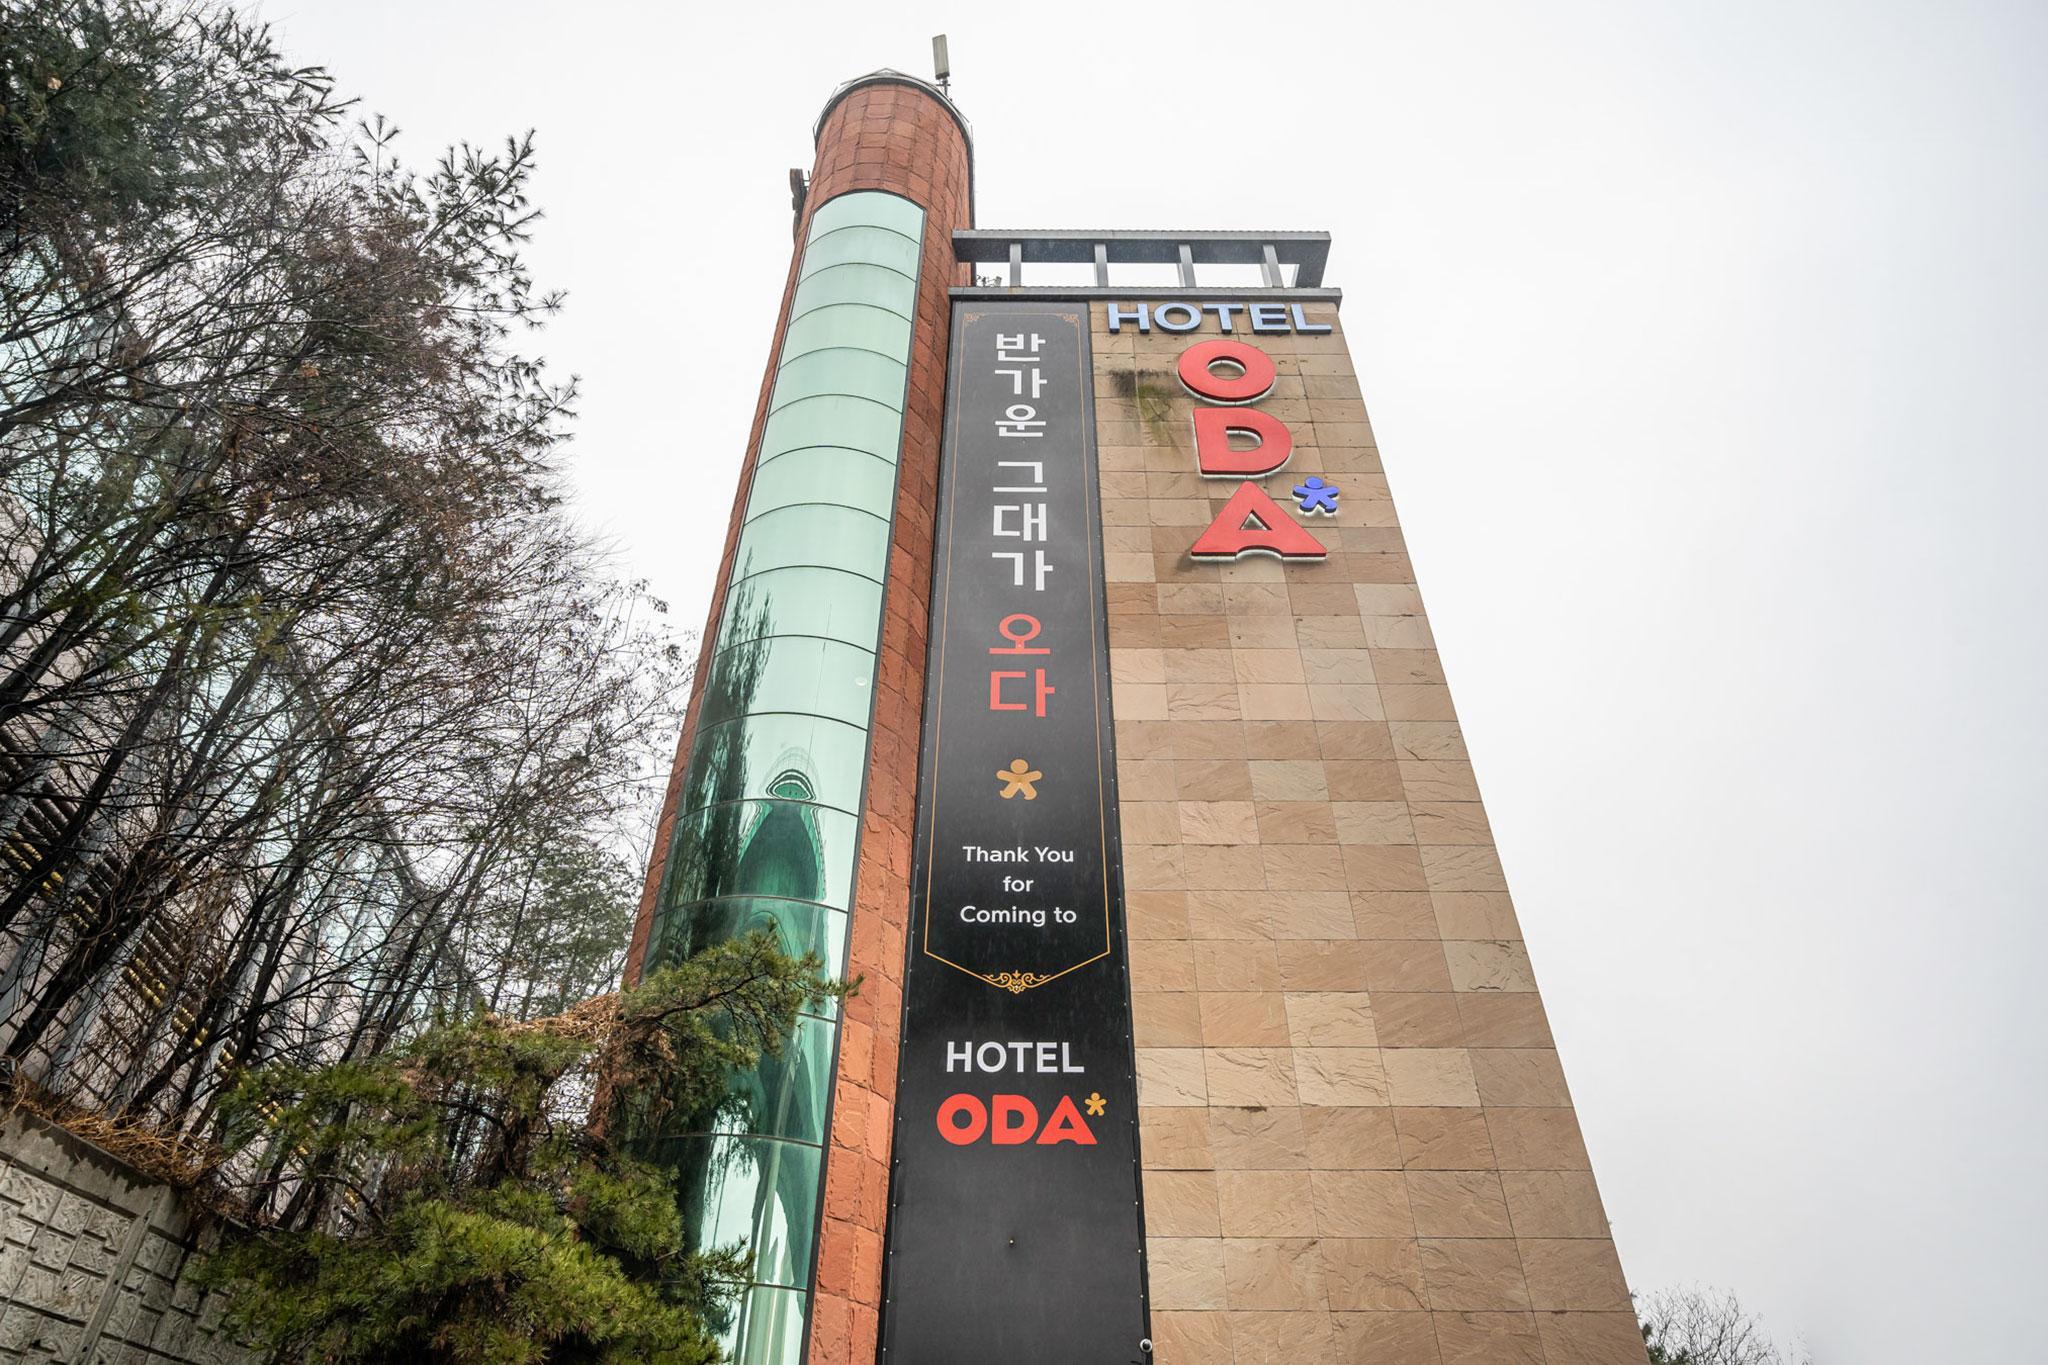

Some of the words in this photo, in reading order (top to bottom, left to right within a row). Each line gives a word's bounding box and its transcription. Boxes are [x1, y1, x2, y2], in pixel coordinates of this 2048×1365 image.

[1107, 302, 1332, 334] HOTEL
[994, 333, 1048, 437] 반가운
[1178, 339, 1327, 561] ODA
[991, 461, 1053, 591] 그대가
[989, 614, 1055, 717] 오다
[962, 845, 1029, 863] Thank
[1034, 846, 1074, 863] You
[1003, 875, 1034, 893] for
[960, 906, 1046, 926] Coming
[1053, 907, 1077, 924] to
[946, 1041, 1085, 1073] HOTEL
[936, 1093, 1098, 1146] ODA
